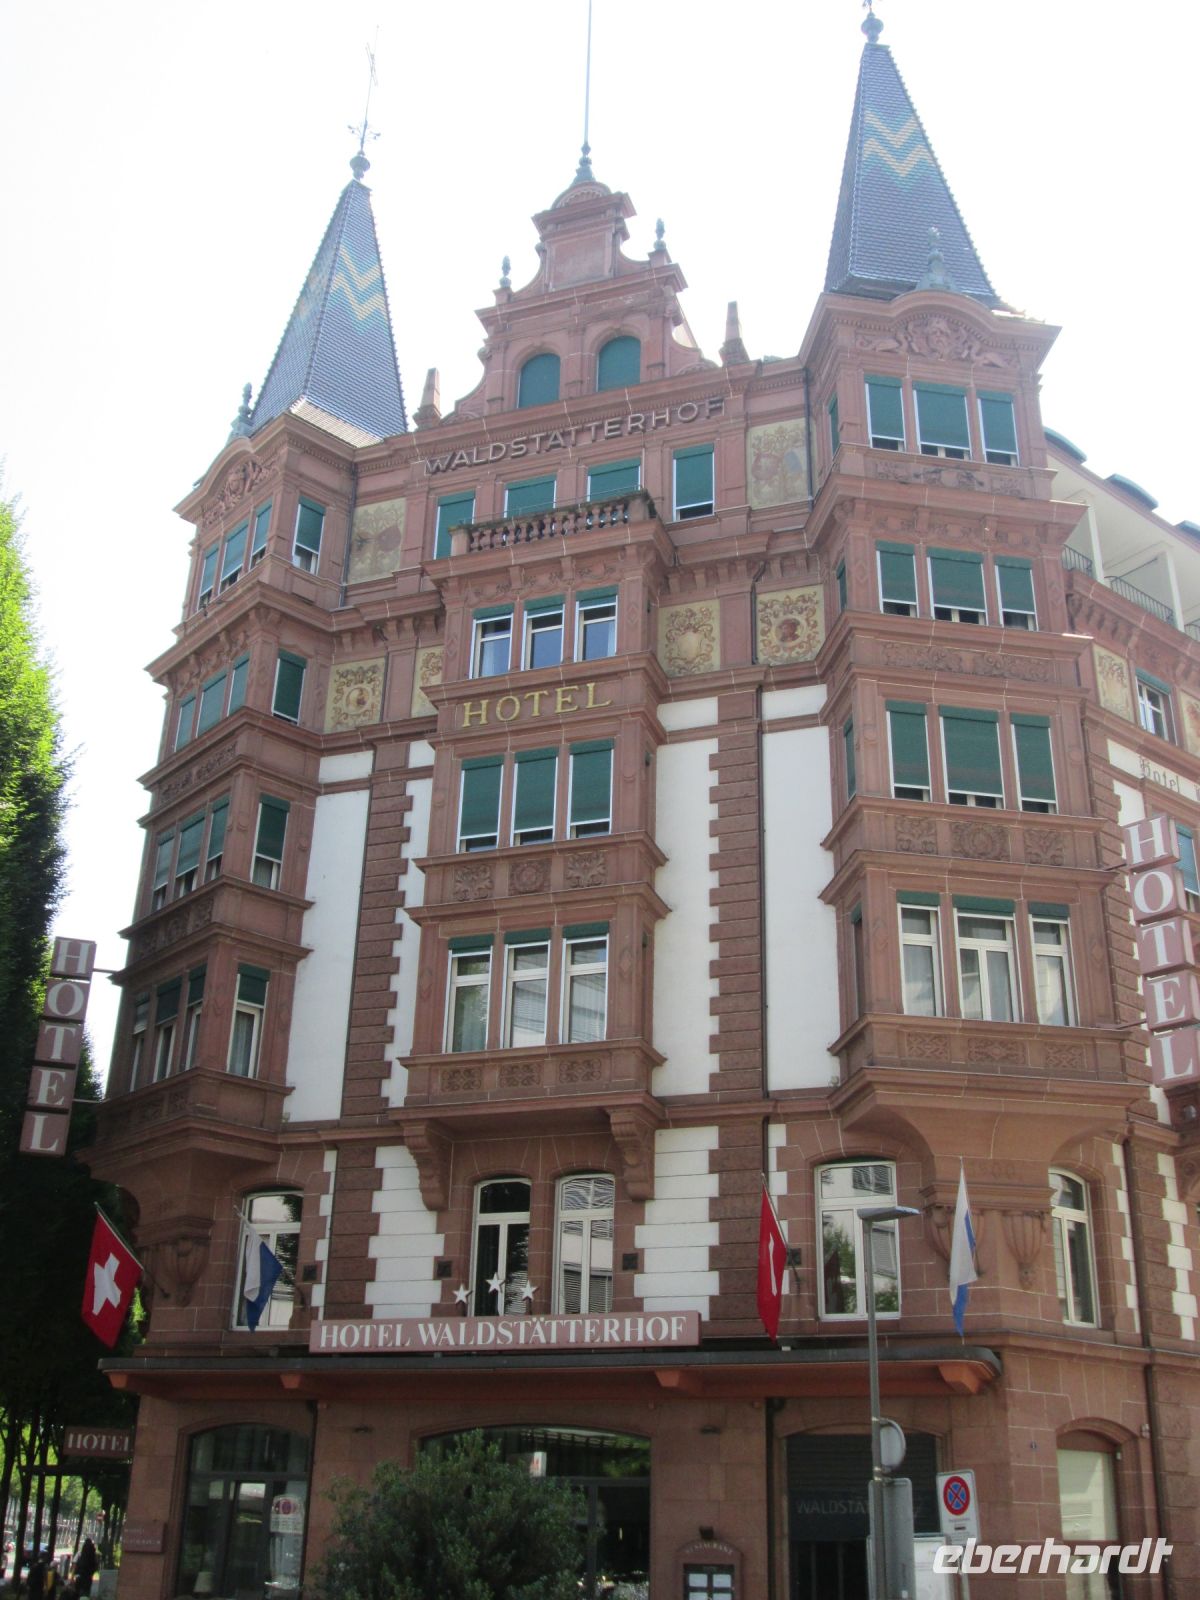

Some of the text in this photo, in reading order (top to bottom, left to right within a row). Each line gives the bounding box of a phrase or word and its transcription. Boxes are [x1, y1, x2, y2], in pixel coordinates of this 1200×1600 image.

[462, 682, 612, 728] HOTEL
[1127, 817, 1193, 1080] HOTEL
[30, 938, 92, 1152] HOTEL
[320, 1316, 688, 1349] HOTEL WALDSTÄTTERHOF
[68, 1432, 133, 1452] HOTEL
